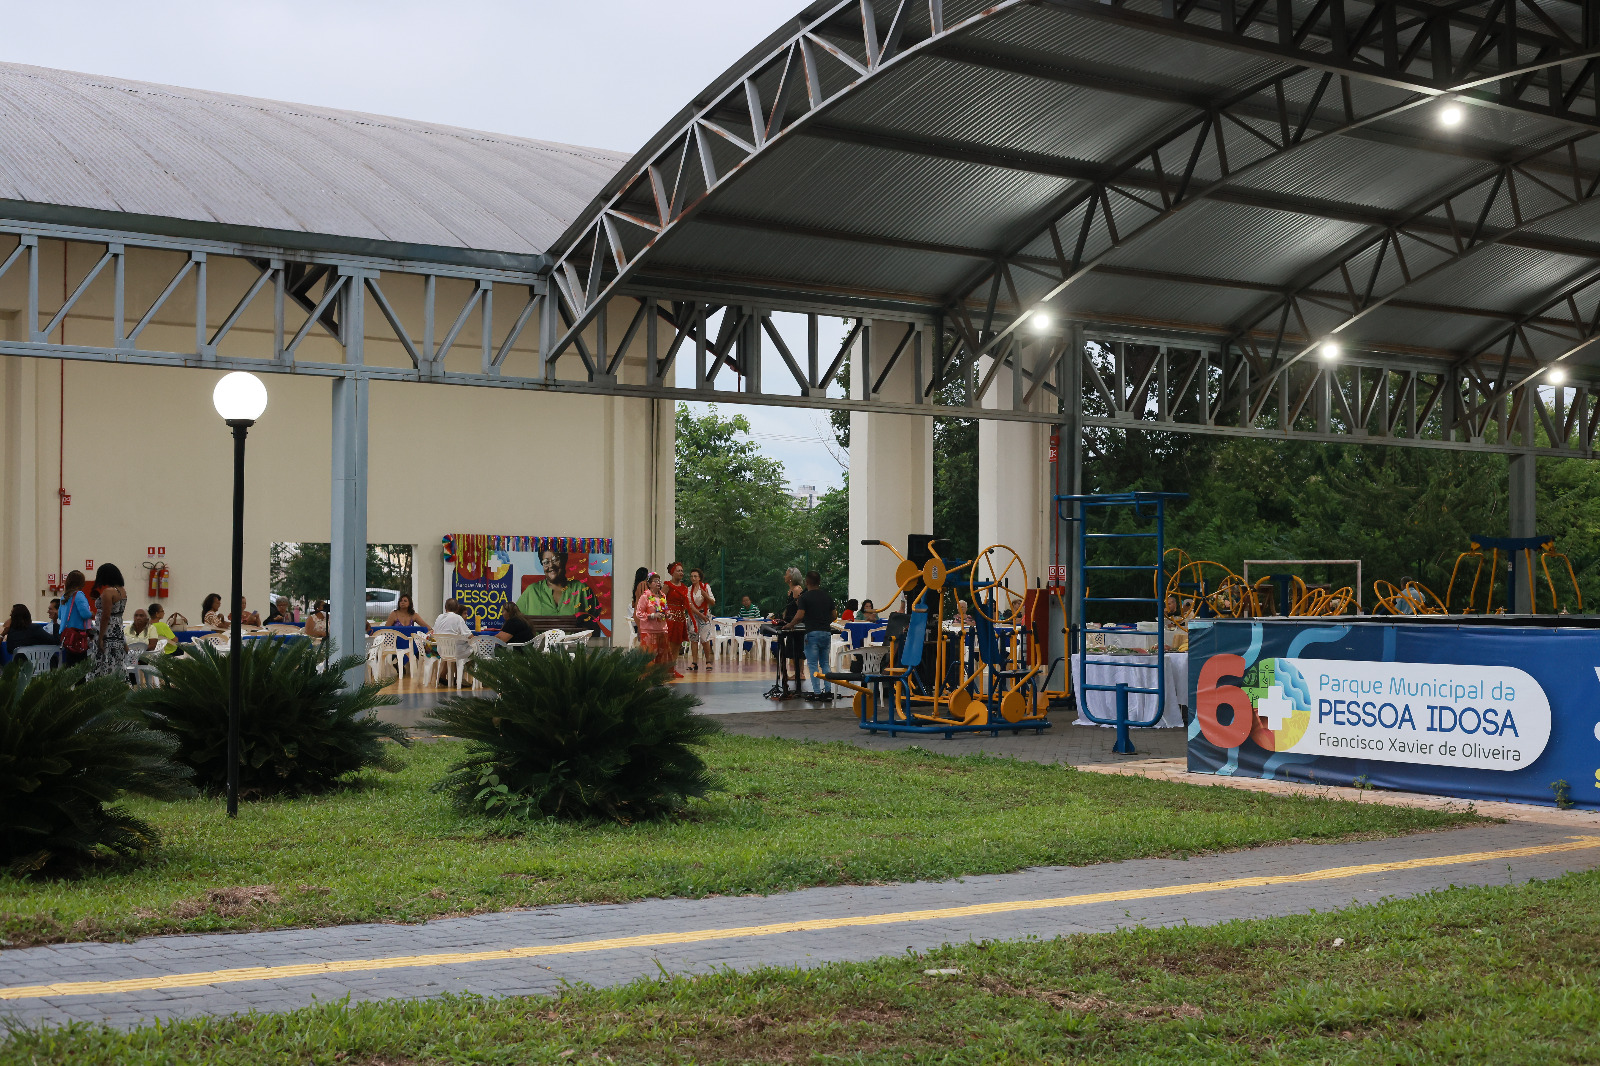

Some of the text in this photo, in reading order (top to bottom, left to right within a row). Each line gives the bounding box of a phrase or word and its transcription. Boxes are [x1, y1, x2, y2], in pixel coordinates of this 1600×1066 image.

[455, 589, 508, 603] PESSOA
[1319, 673, 1516, 704] Parque Municipal da
[1318, 698, 1520, 738] PESSOA IDOSA
[1319, 732, 1521, 762] Francisco Xavier de Oliveira
